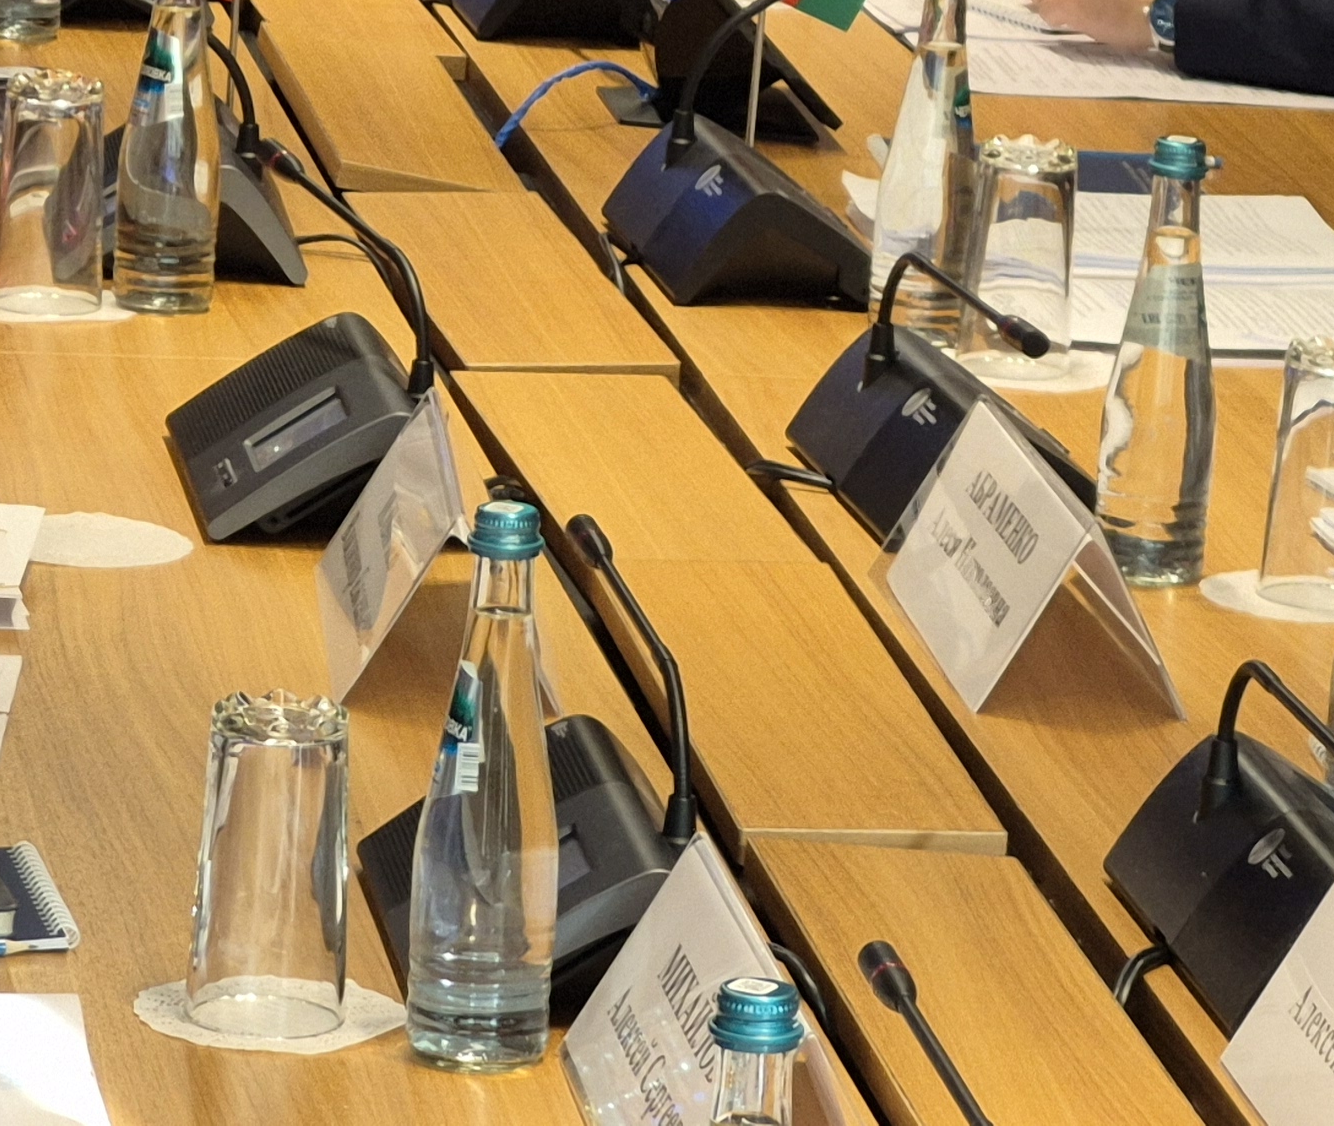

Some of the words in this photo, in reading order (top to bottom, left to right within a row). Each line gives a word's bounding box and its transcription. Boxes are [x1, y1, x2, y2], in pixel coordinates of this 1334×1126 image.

[965, 470, 1040, 565] АБРАМЕНКО
[607, 987, 660, 1077] Алексей
[640, 1055, 684, 1126] Серге
[658, 943, 717, 1083] МИХАЙЛО
